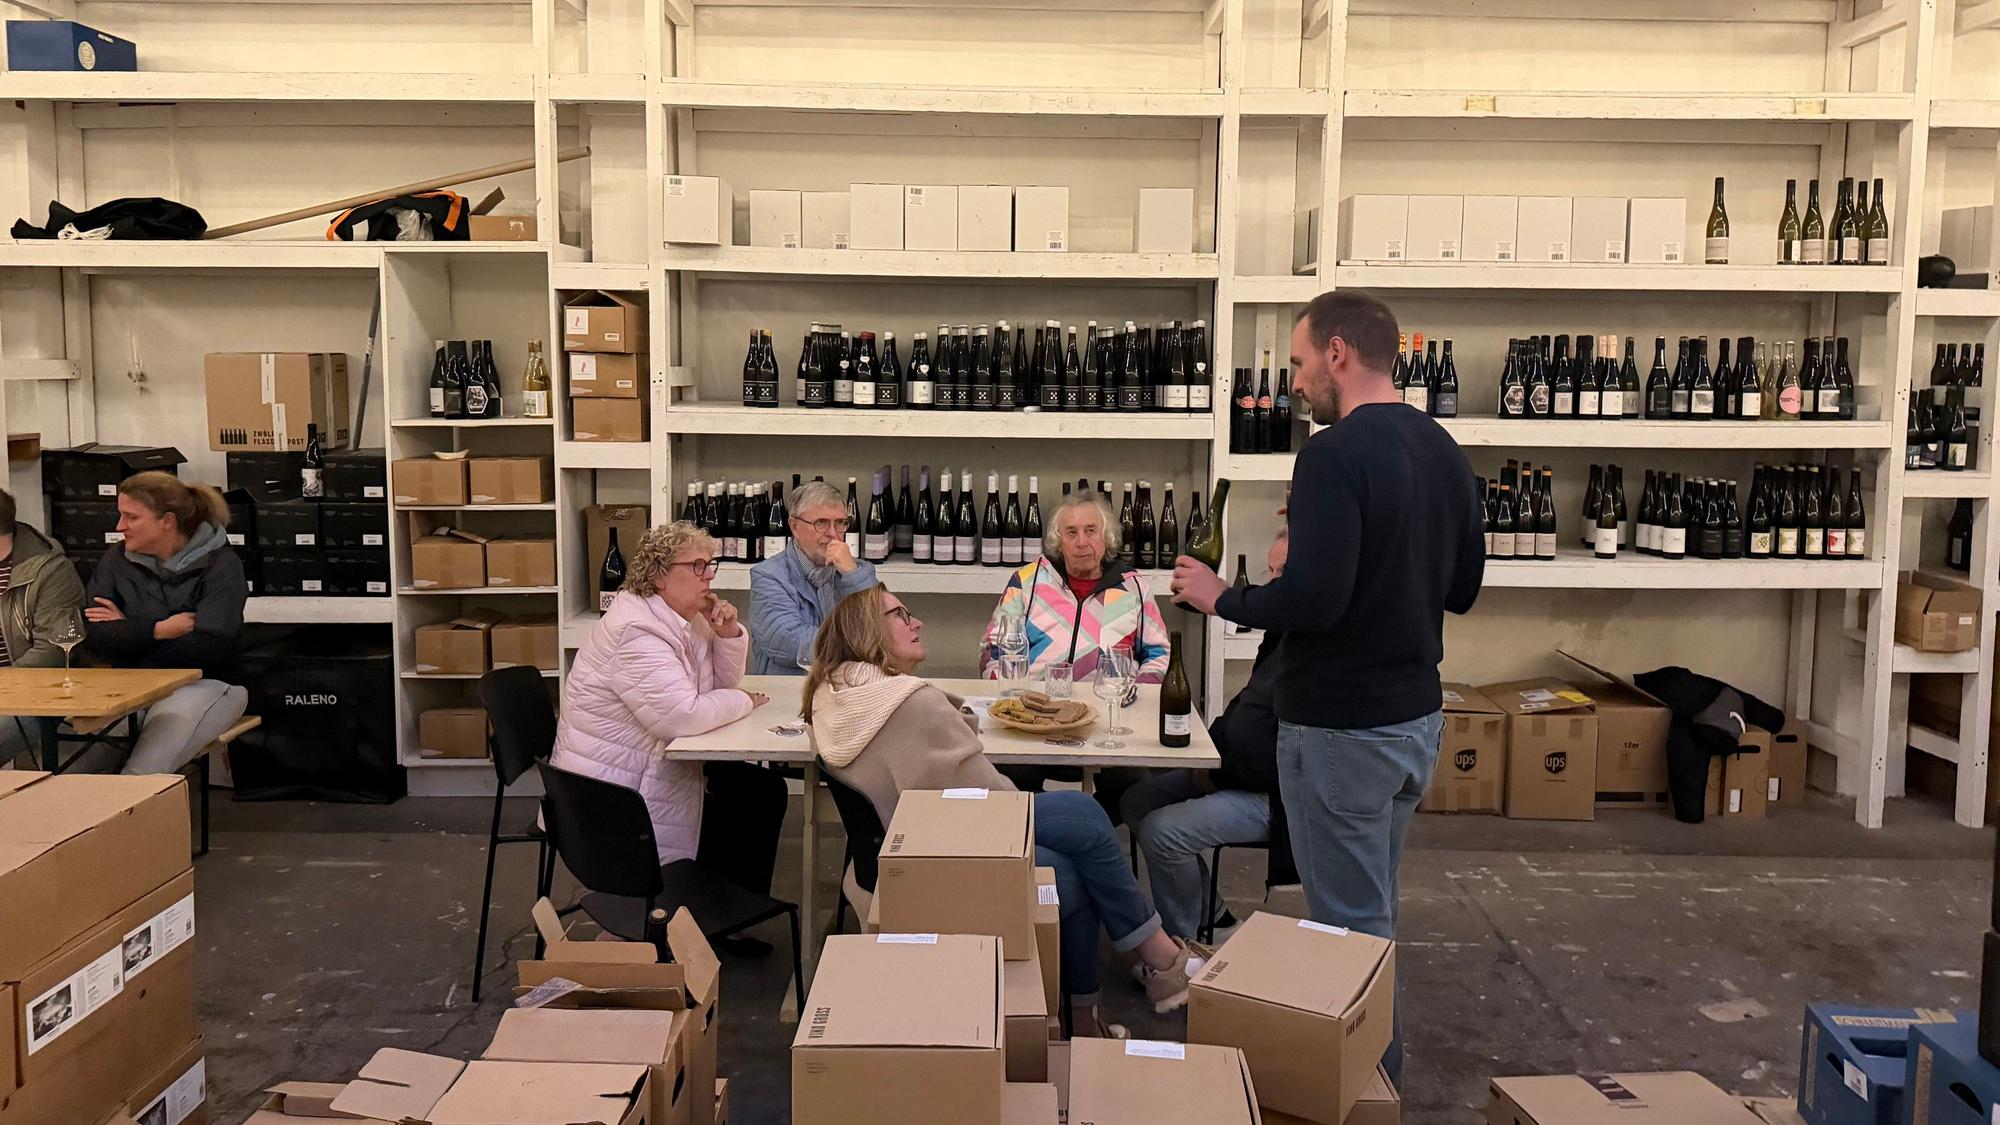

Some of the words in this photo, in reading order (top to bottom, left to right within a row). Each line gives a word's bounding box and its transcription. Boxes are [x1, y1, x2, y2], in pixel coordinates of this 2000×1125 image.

[285, 694, 337, 705] RALENO
[1456, 754, 1476, 769] ups
[1545, 756, 1565, 771] ups
[812, 1007, 831, 1024] GROSS
[808, 1026, 826, 1039] VINO
